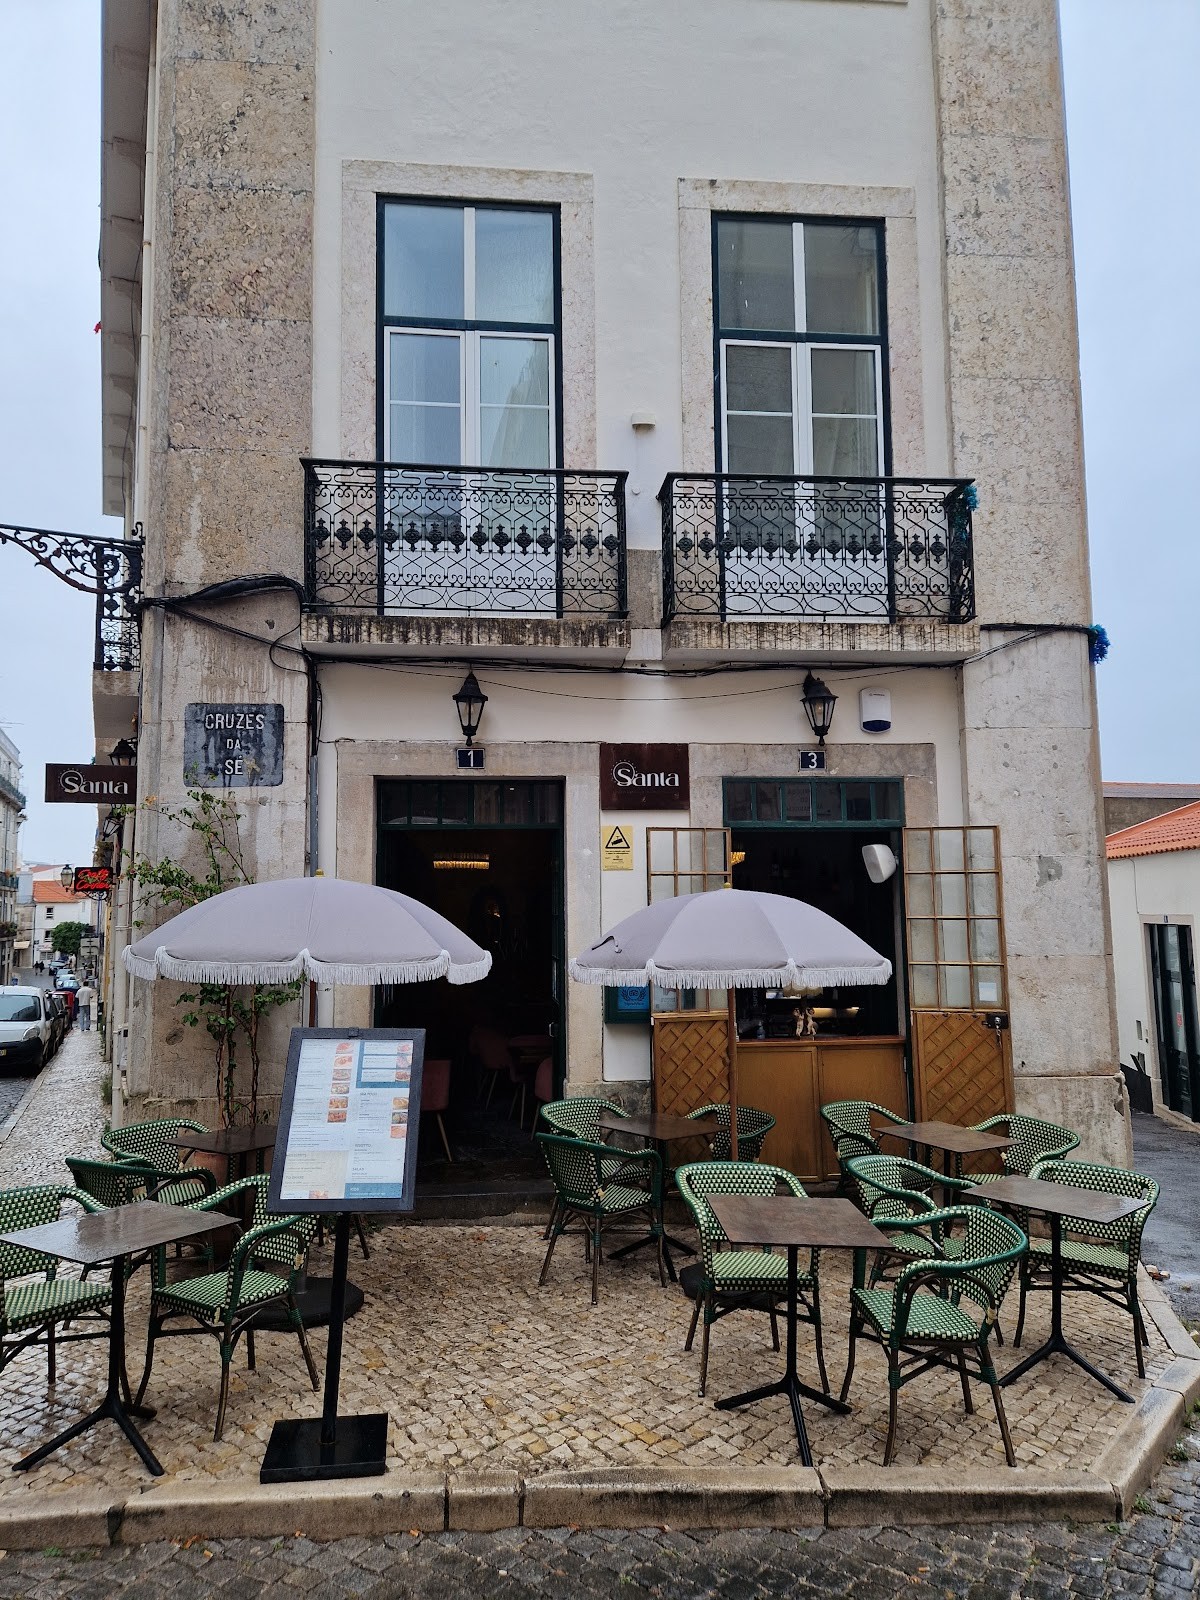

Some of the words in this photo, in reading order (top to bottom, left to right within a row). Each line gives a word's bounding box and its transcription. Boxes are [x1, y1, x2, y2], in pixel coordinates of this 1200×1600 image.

[205, 713, 265, 730] CRUZES
[226, 738, 242, 750] DA
[224, 755, 244, 775] SÉ
[467, 750, 474, 767] 1
[807, 752, 818, 769] 3
[61, 771, 129, 795] Santa
[613, 763, 680, 787] Santa
